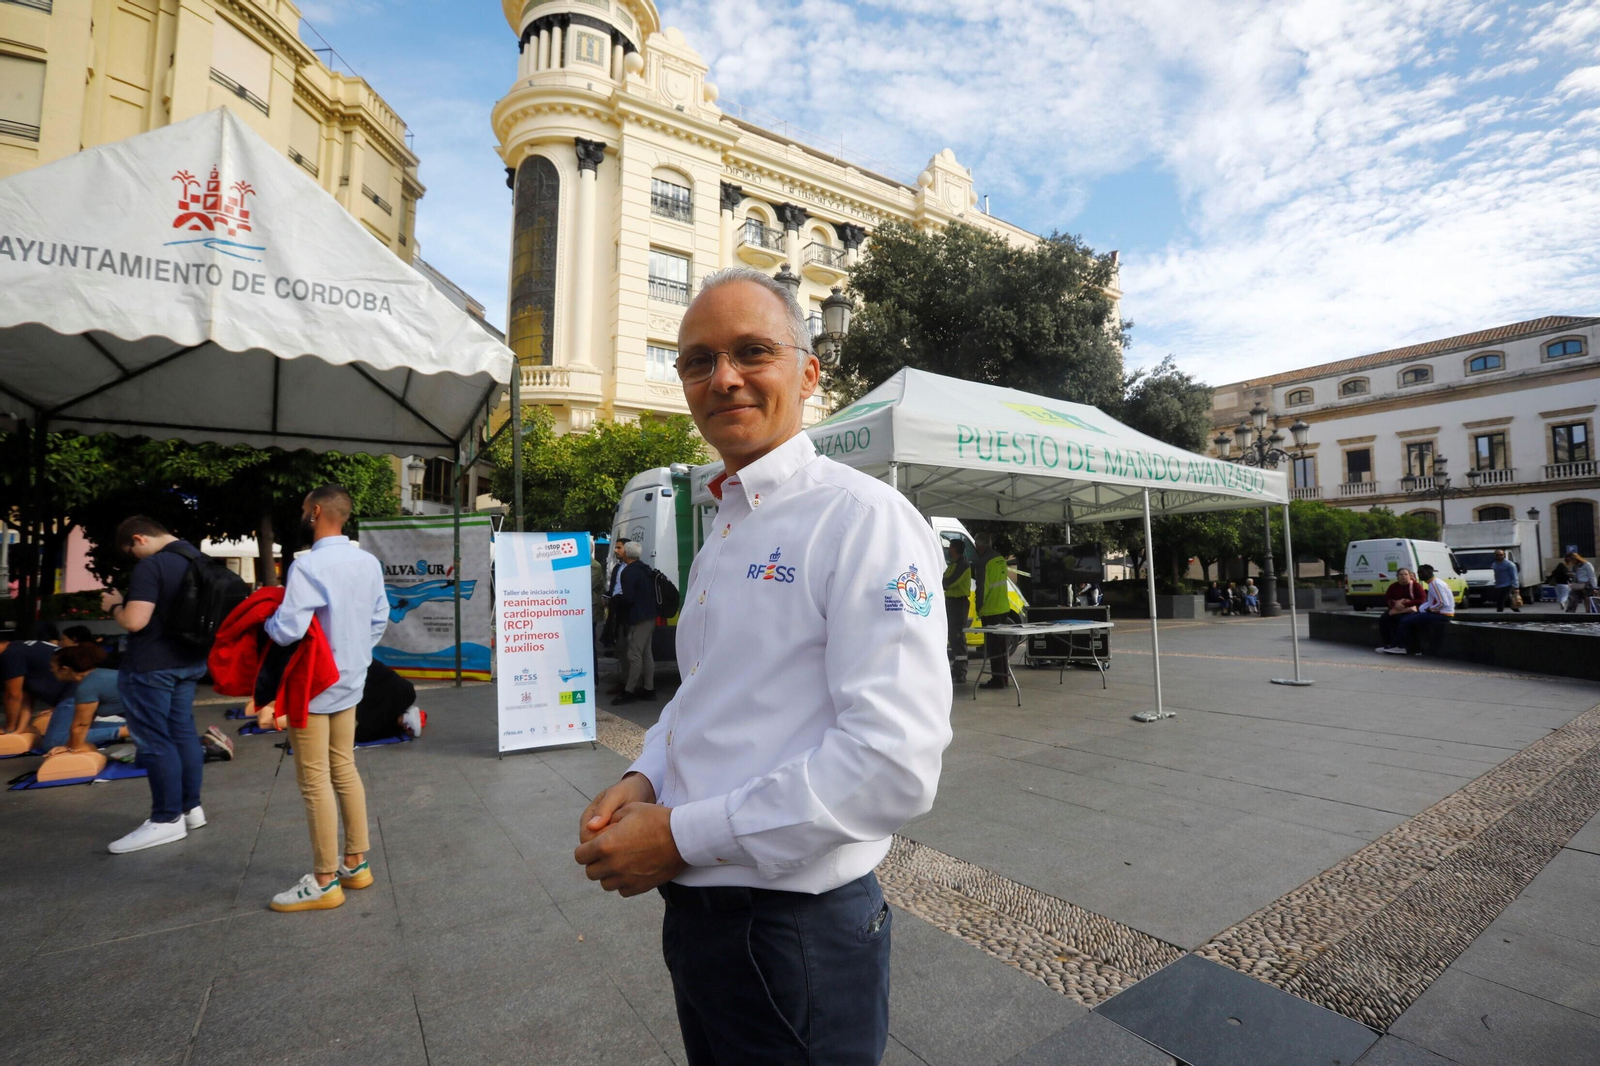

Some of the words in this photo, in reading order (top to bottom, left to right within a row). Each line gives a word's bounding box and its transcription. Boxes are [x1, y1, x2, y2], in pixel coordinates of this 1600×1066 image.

[0, 235, 223, 287] AYUNTAMIENTO
[231, 269, 266, 295] DE
[274, 276, 393, 316] CORDOBA
[814, 426, 871, 457] NZADO
[956, 424, 1060, 469] PUESTO
[1066, 440, 1097, 473] DE
[1104, 446, 1182, 483] MANDO
[1185, 459, 1265, 494] AVANZADO
[536, 550, 562, 559] ahogados
[382, 560, 446, 576] ALVASUR
[746, 564, 796, 583] RFESS
[503, 596, 567, 607] reanimación
[503, 608, 586, 619] cardiopulmonar
[503, 619, 534, 631] (RCP)
[504, 634, 511, 643] y
[513, 631, 560, 643] primeros
[504, 643, 545, 653] auxilios
